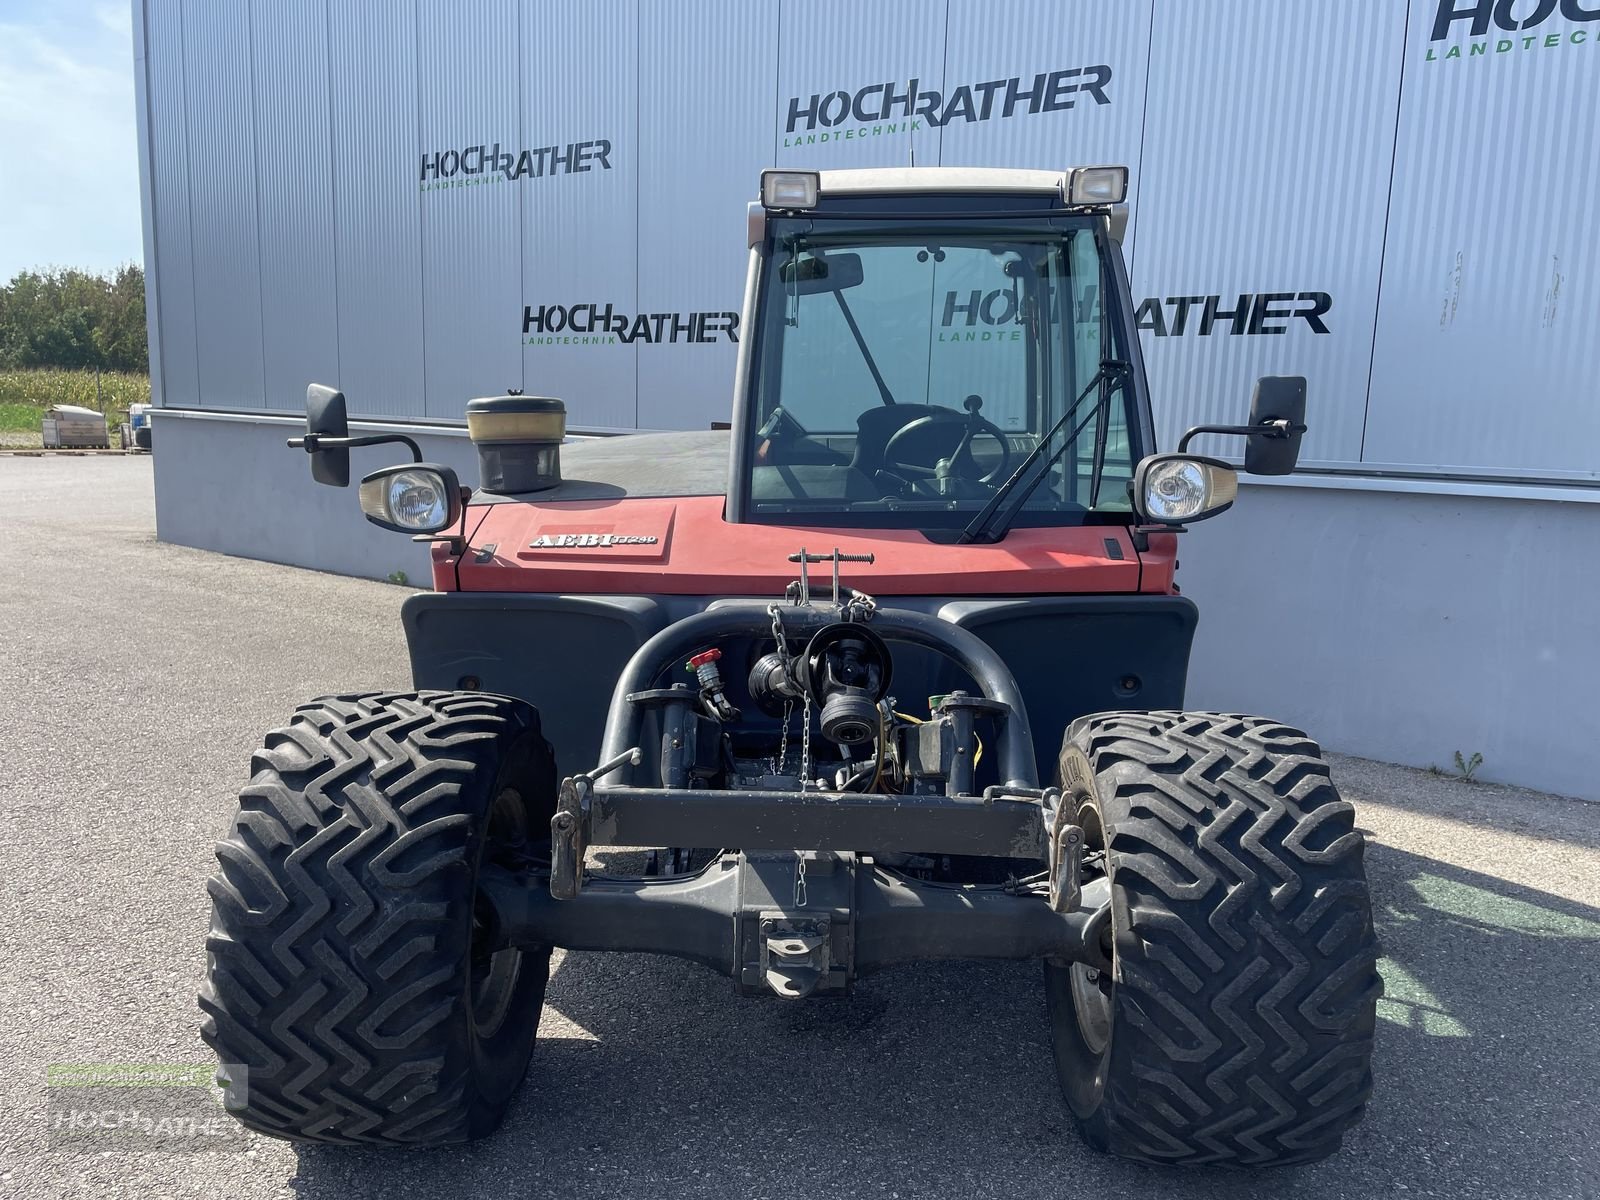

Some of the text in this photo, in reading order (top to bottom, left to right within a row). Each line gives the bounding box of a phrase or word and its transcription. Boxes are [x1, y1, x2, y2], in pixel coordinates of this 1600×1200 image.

[1425, 30, 1600, 61] LANDTEC
[785, 64, 1113, 133] HOCHRATHER
[784, 120, 921, 148] LANDTECHNIK
[421, 139, 612, 181] HOCHRATHER
[420, 175, 503, 192] LANDTECHNIK
[522, 303, 739, 344] HOCHRATHER
[521, 336, 615, 345] LANDTECHNIK
[529, 534, 614, 548] AEBI
